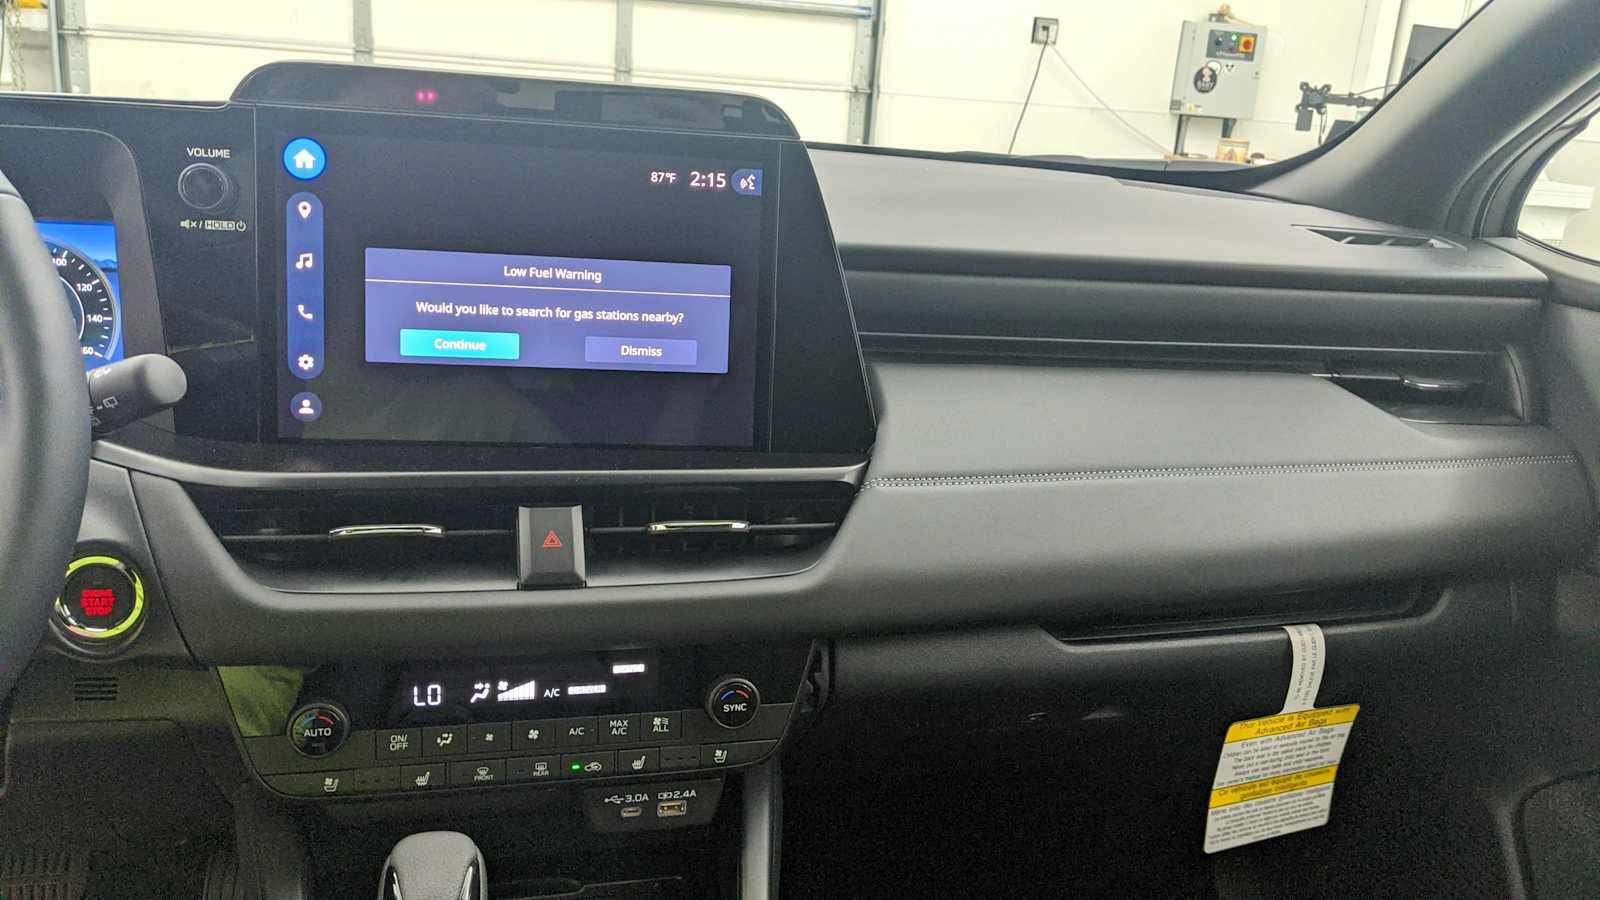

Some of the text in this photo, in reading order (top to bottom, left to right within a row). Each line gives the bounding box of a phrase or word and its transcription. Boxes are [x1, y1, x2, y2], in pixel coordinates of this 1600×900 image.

[186, 147, 231, 158] VOLUME
[690, 171, 726, 188] 2:15
[206, 220, 235, 230] HOLD
[52, 257, 68, 266] 100
[503, 266, 602, 283] Low Fuel Warning
[76, 283, 93, 292] 120
[416, 301, 685, 325] Would you like to search for gas stations nearby?
[86, 314, 103, 323] 140
[434, 338, 487, 351] Continue
[82, 346, 94, 355] 60
[621, 345, 663, 357] Dismiss
[81, 597, 116, 608] START
[413, 684, 442, 706] LO
[544, 688, 561, 698] A/C
[723, 703, 747, 713] SYNC
[304, 728, 332, 737] AUTO
[568, 727, 585, 736] A/C
[611, 727, 627, 736] A/C
[652, 725, 669, 733] ALL
[390, 734, 408, 743] ON/
[389, 742, 409, 751] OFF
[474, 774, 494, 782] FRONT
[625, 793, 649, 803] 3.0A
[673, 790, 697, 799] 2.4A
